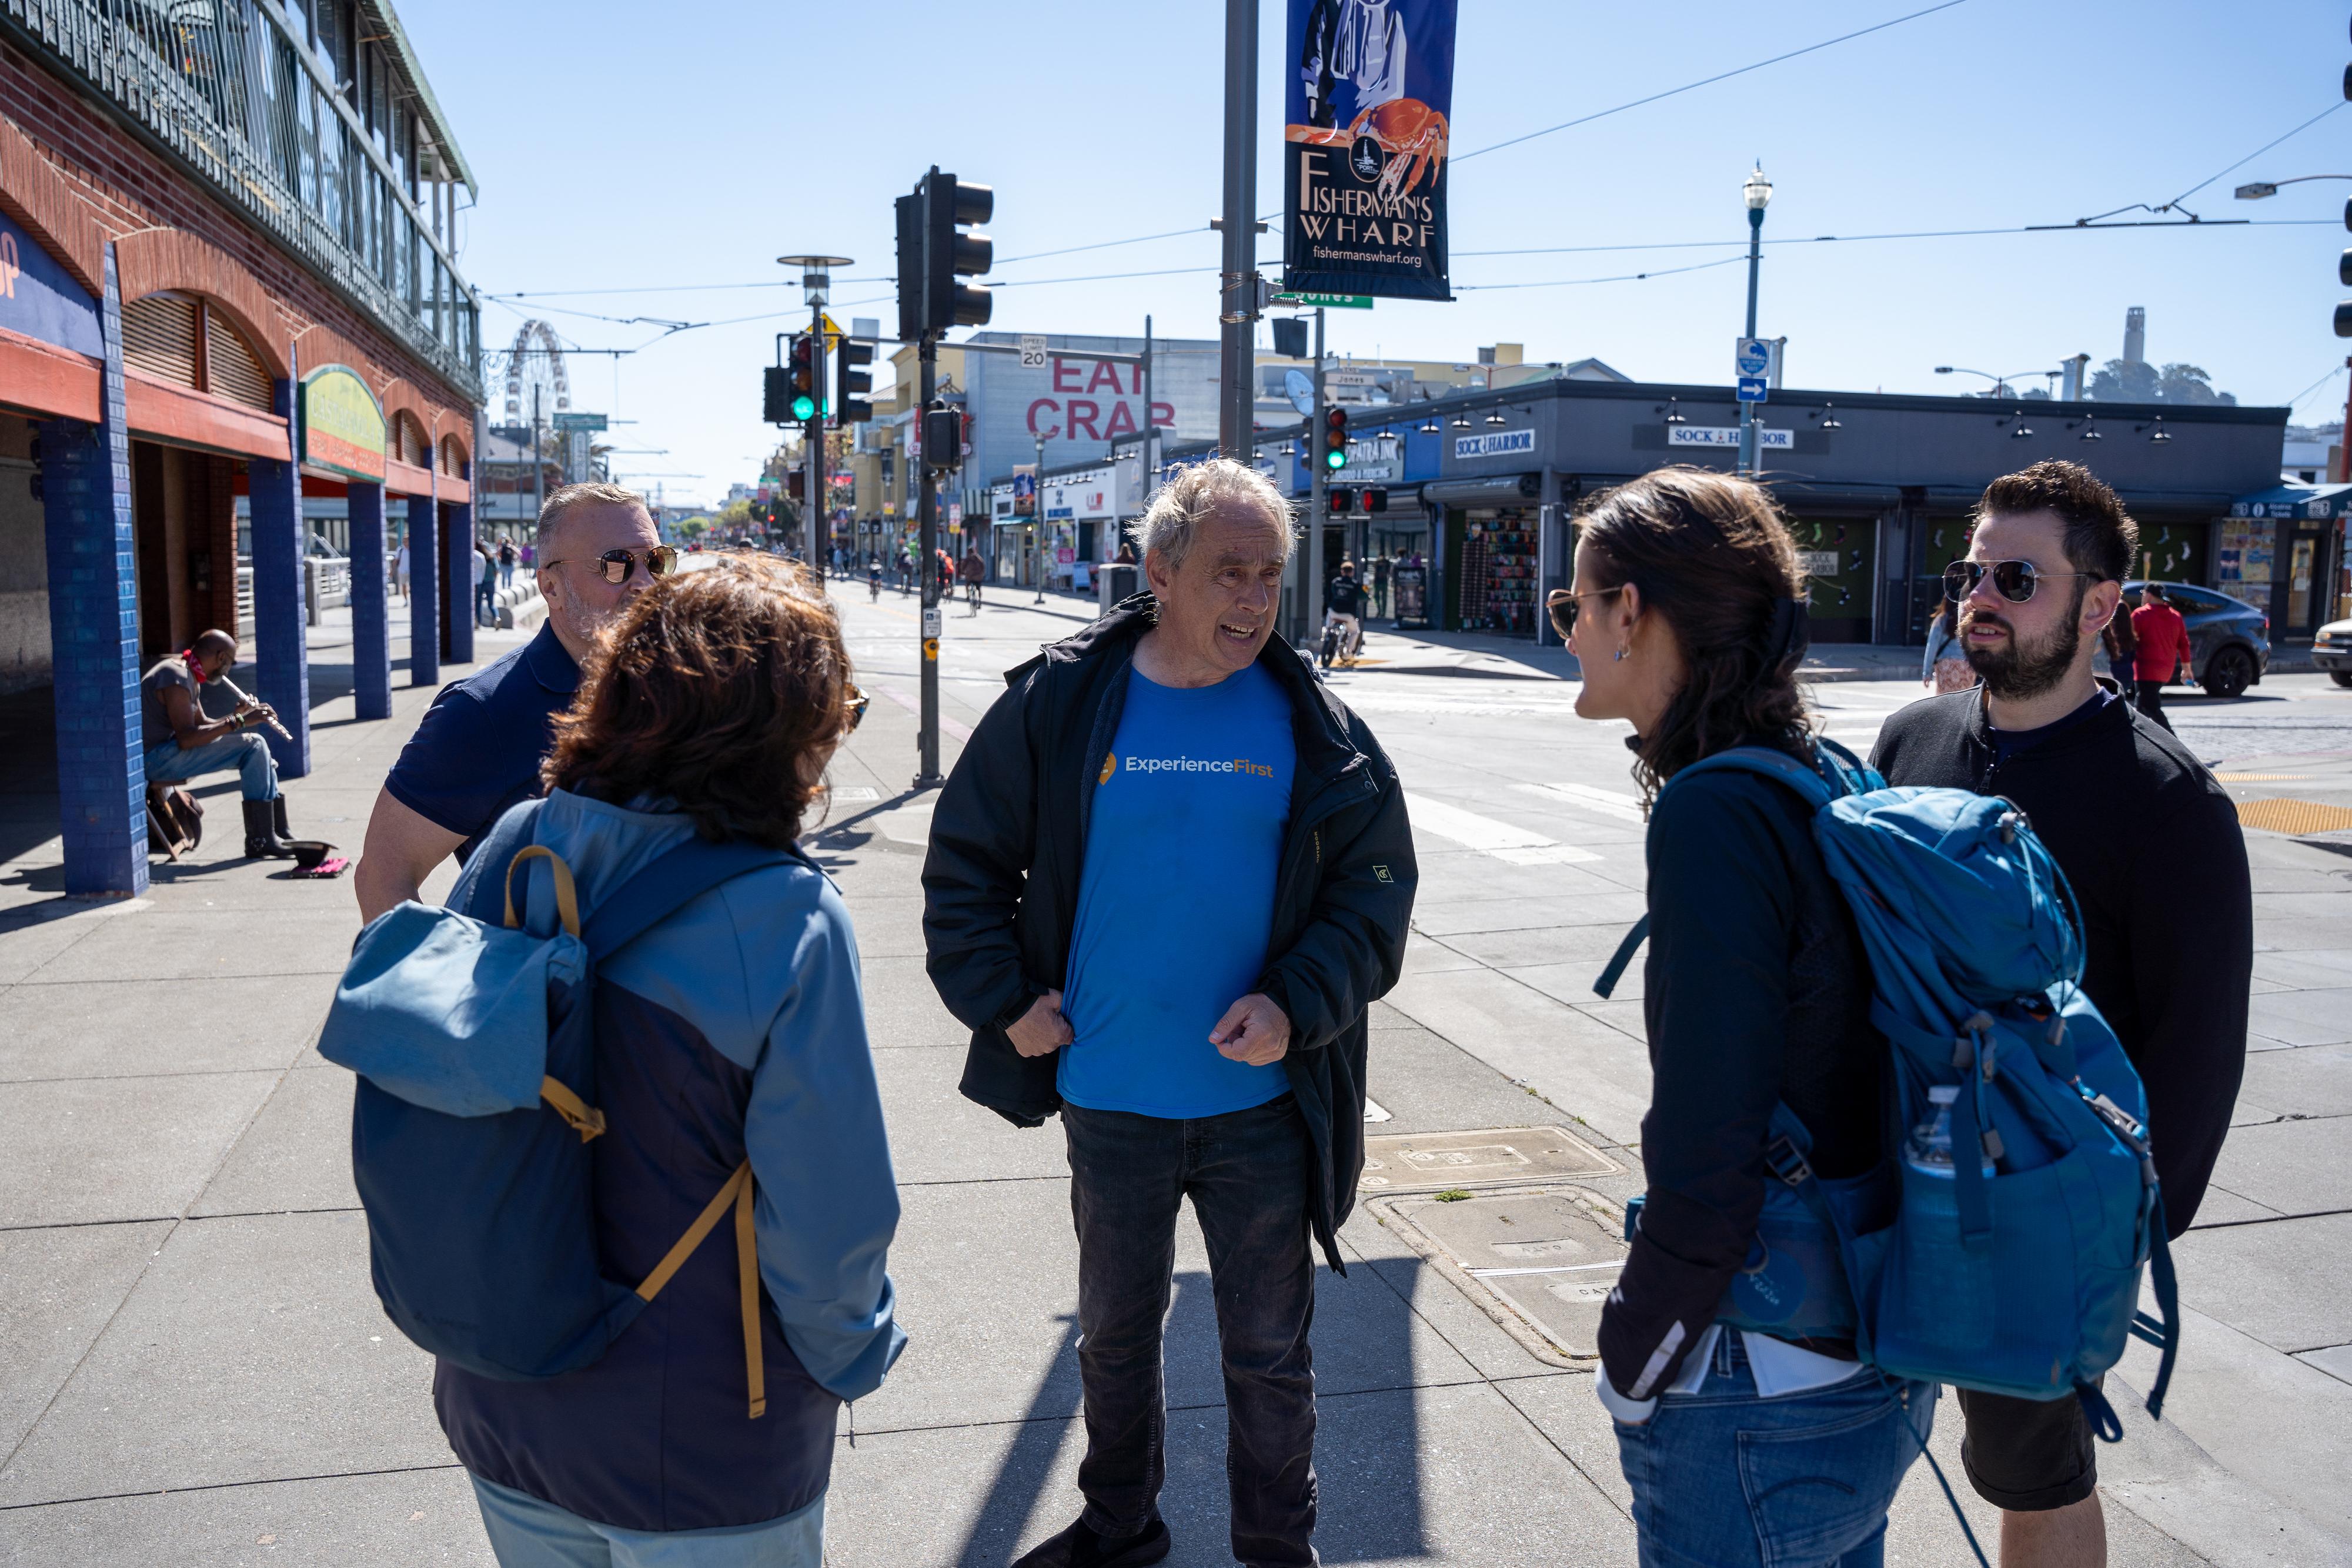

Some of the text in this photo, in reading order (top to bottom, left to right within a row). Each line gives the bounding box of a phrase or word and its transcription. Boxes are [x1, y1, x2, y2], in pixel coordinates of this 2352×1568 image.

[1300, 151, 1434, 222] FISHERMAN'S
[1299, 215, 1435, 247] WHARF
[1312, 245, 1422, 268] fishermanswharf.org
[1024, 353, 1044, 365] 20
[1457, 433, 1531, 455] SOCK HARBOR
[1675, 430, 1787, 445] SOCK HBOR
[1125, 755, 1274, 778] ExperienceFirst
[1579, 1287, 1616, 1295] CAT
